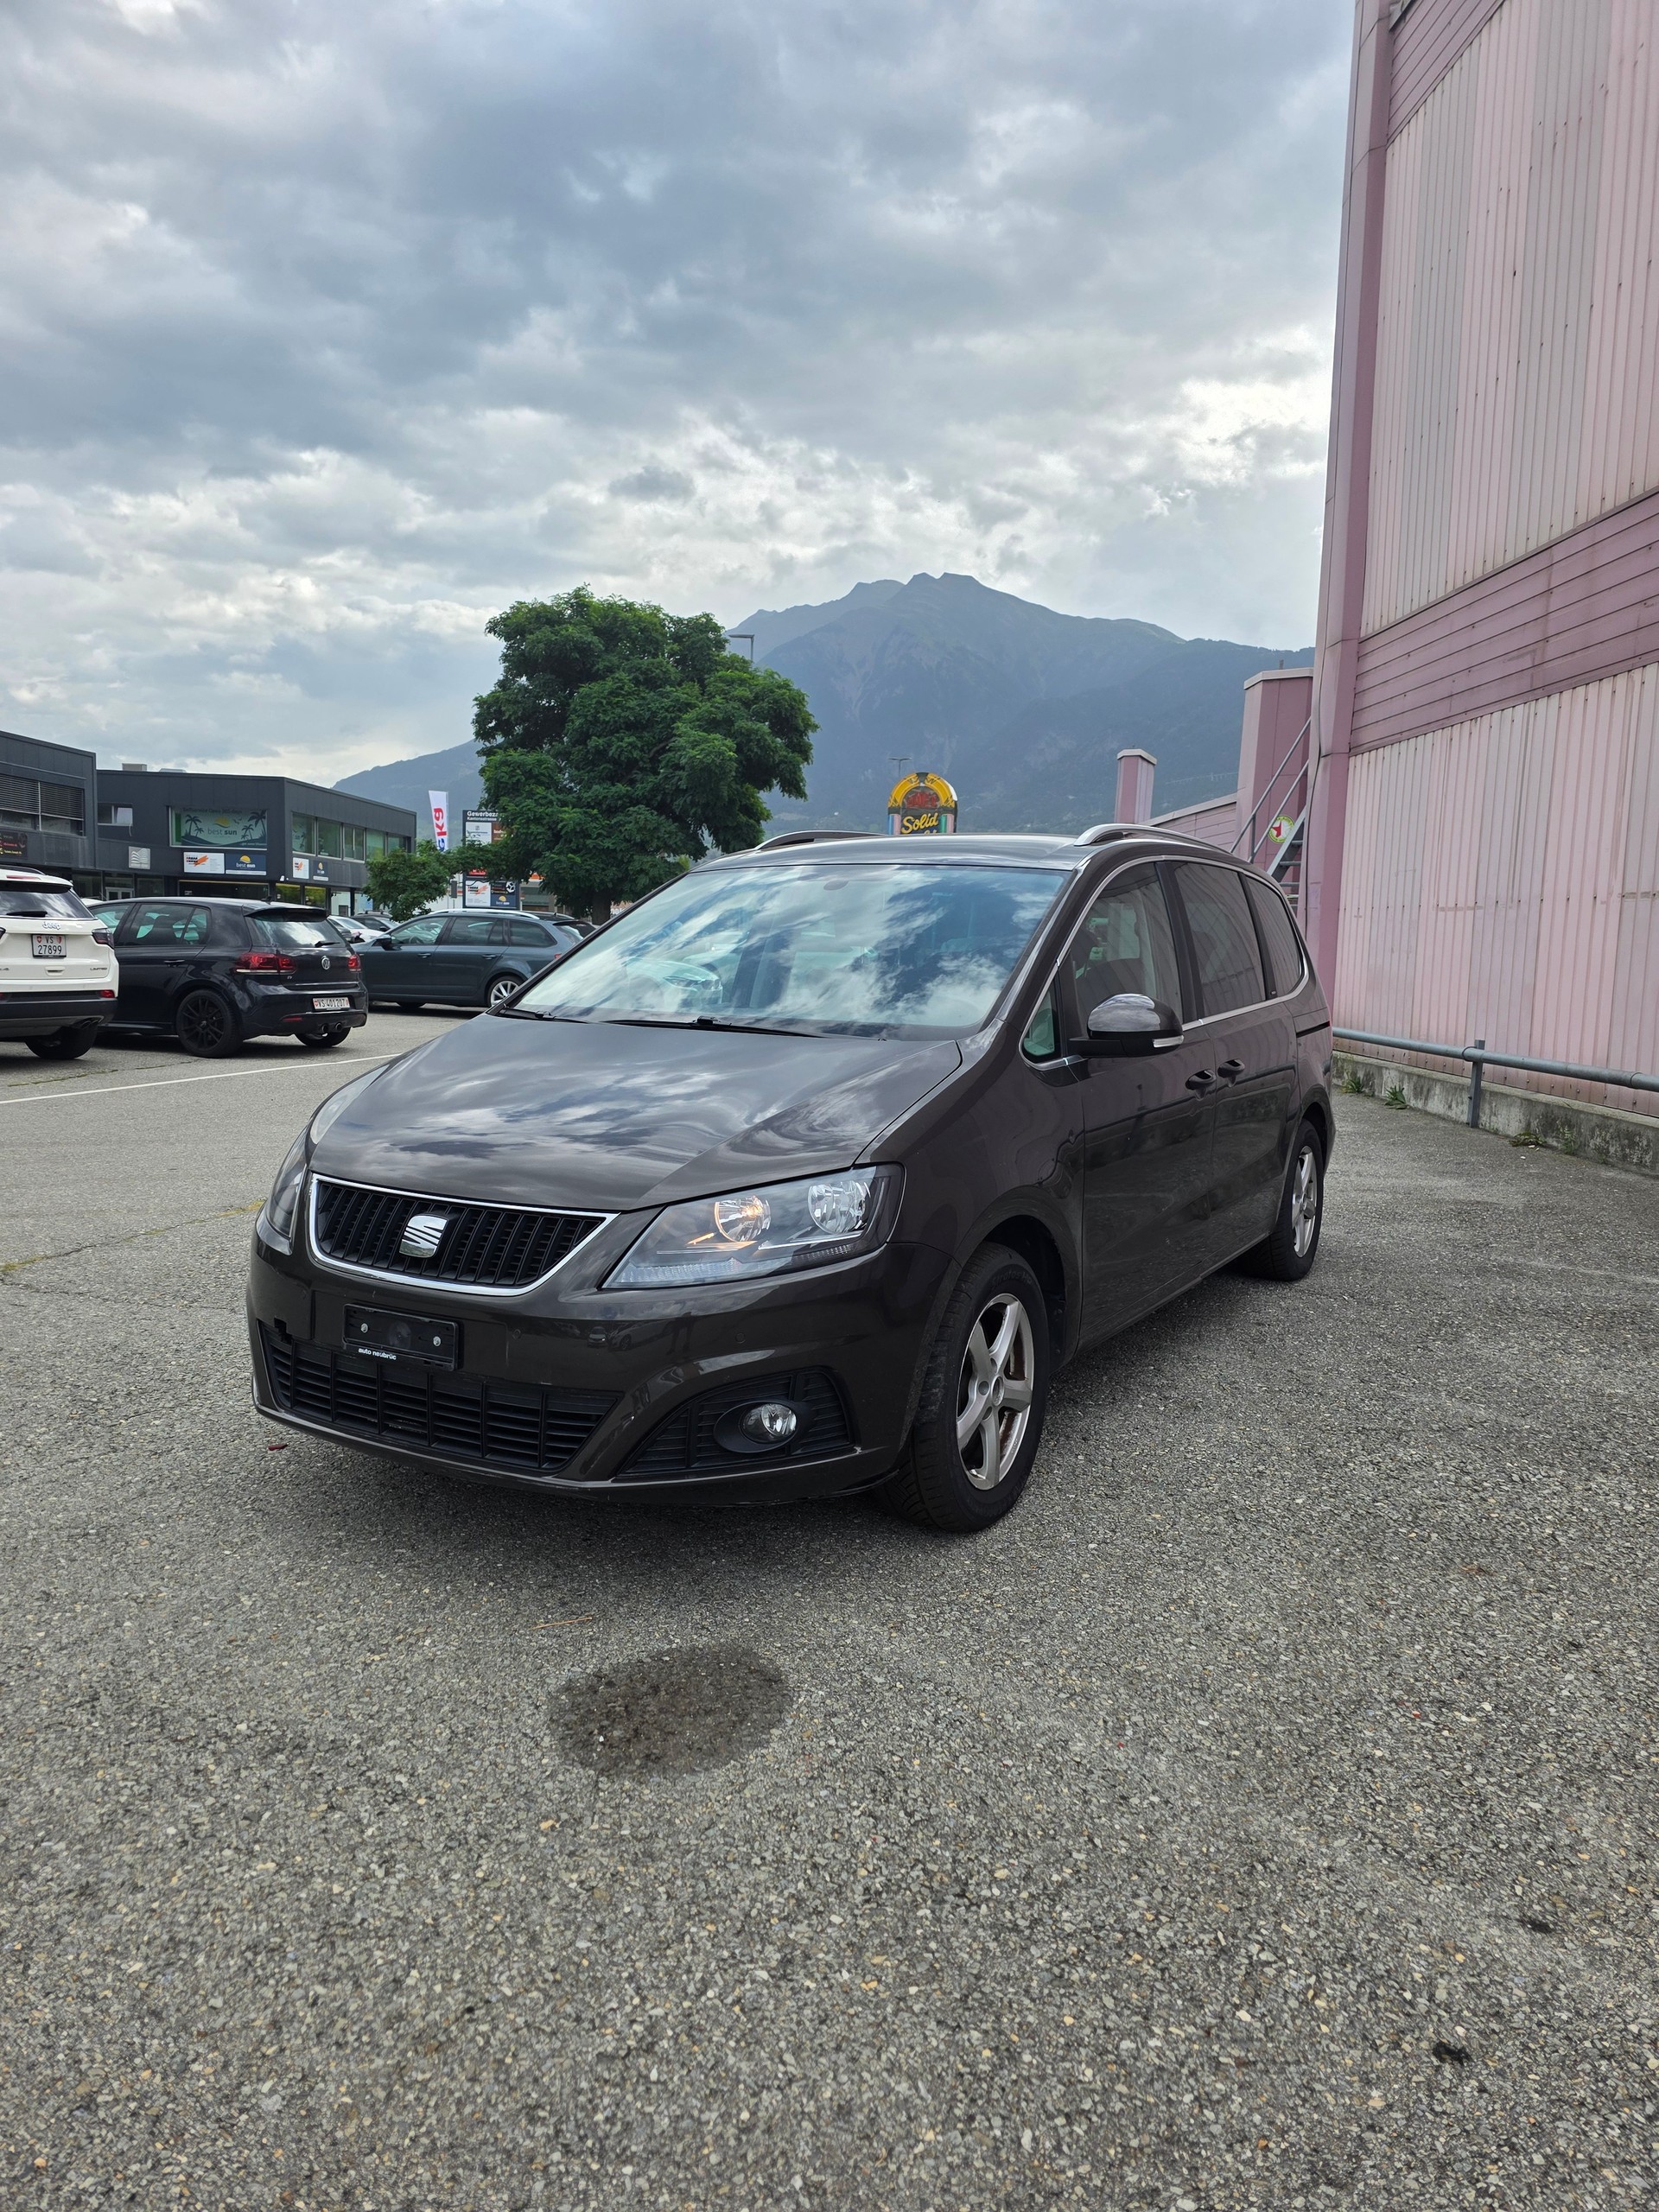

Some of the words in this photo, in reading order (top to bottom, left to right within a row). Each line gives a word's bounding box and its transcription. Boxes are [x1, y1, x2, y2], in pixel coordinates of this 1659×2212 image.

[901, 812, 938, 834] Solid
[42, 921, 61, 930] Jeep
[38, 944, 62, 955] 27899
[327, 998, 346, 1007] 401207
